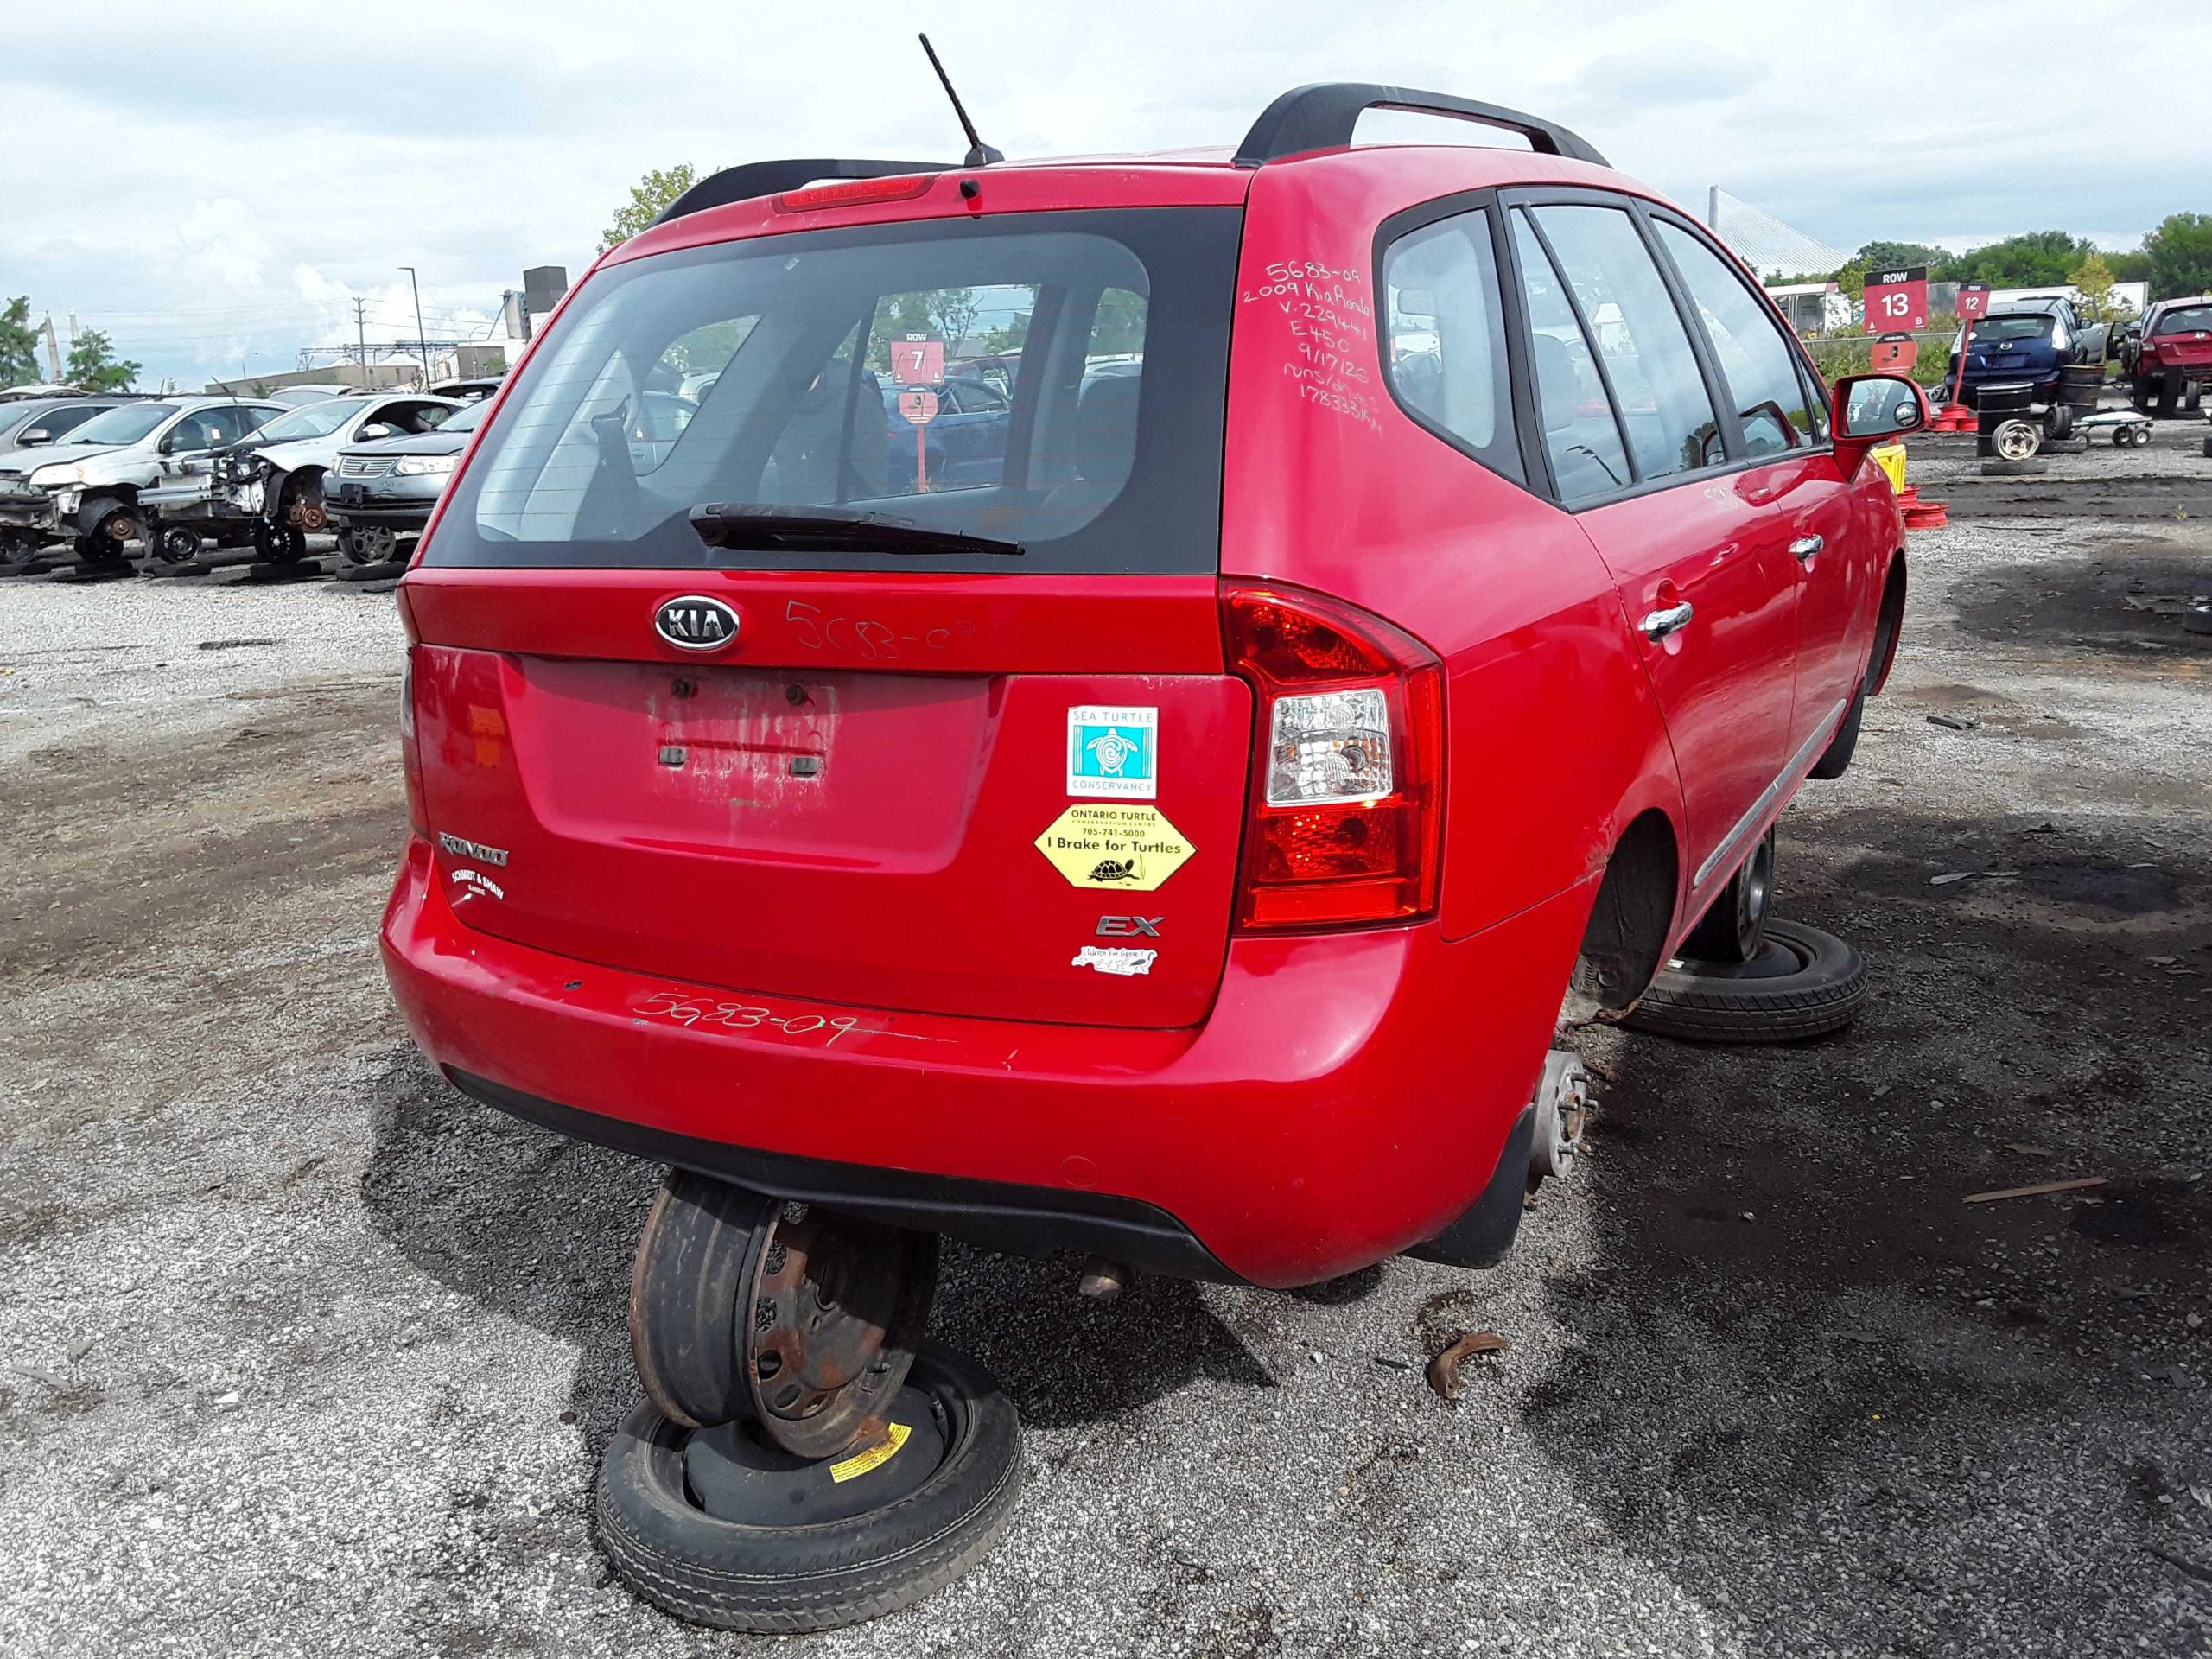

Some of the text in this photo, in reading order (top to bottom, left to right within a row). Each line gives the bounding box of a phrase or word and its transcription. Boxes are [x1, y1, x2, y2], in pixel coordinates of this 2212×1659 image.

[1265, 260, 1362, 283] 5683-09
[1883, 271, 1908, 283] ROW
[1243, 283, 1299, 302] 2009
[1305, 282, 1335, 305] Kia
[1881, 292, 1909, 317] 13
[1965, 296, 1979, 310] 12
[1916, 316, 1923, 325] B
[906, 333, 927, 342] ROW
[912, 351, 924, 371] 7
[667, 609, 725, 638] KIA
[1073, 710, 1154, 723] SEA TURTLE
[1072, 779, 1153, 791] CONSERVANCY
[1071, 810, 1156, 822] ONTARIO TURTLE
[1082, 828, 1146, 838] 705-741-5000
[1047, 836, 1181, 854] I Brake for Turtles
[1095, 915, 1166, 937] EX
[632, 993, 857, 1046] 5683-09
